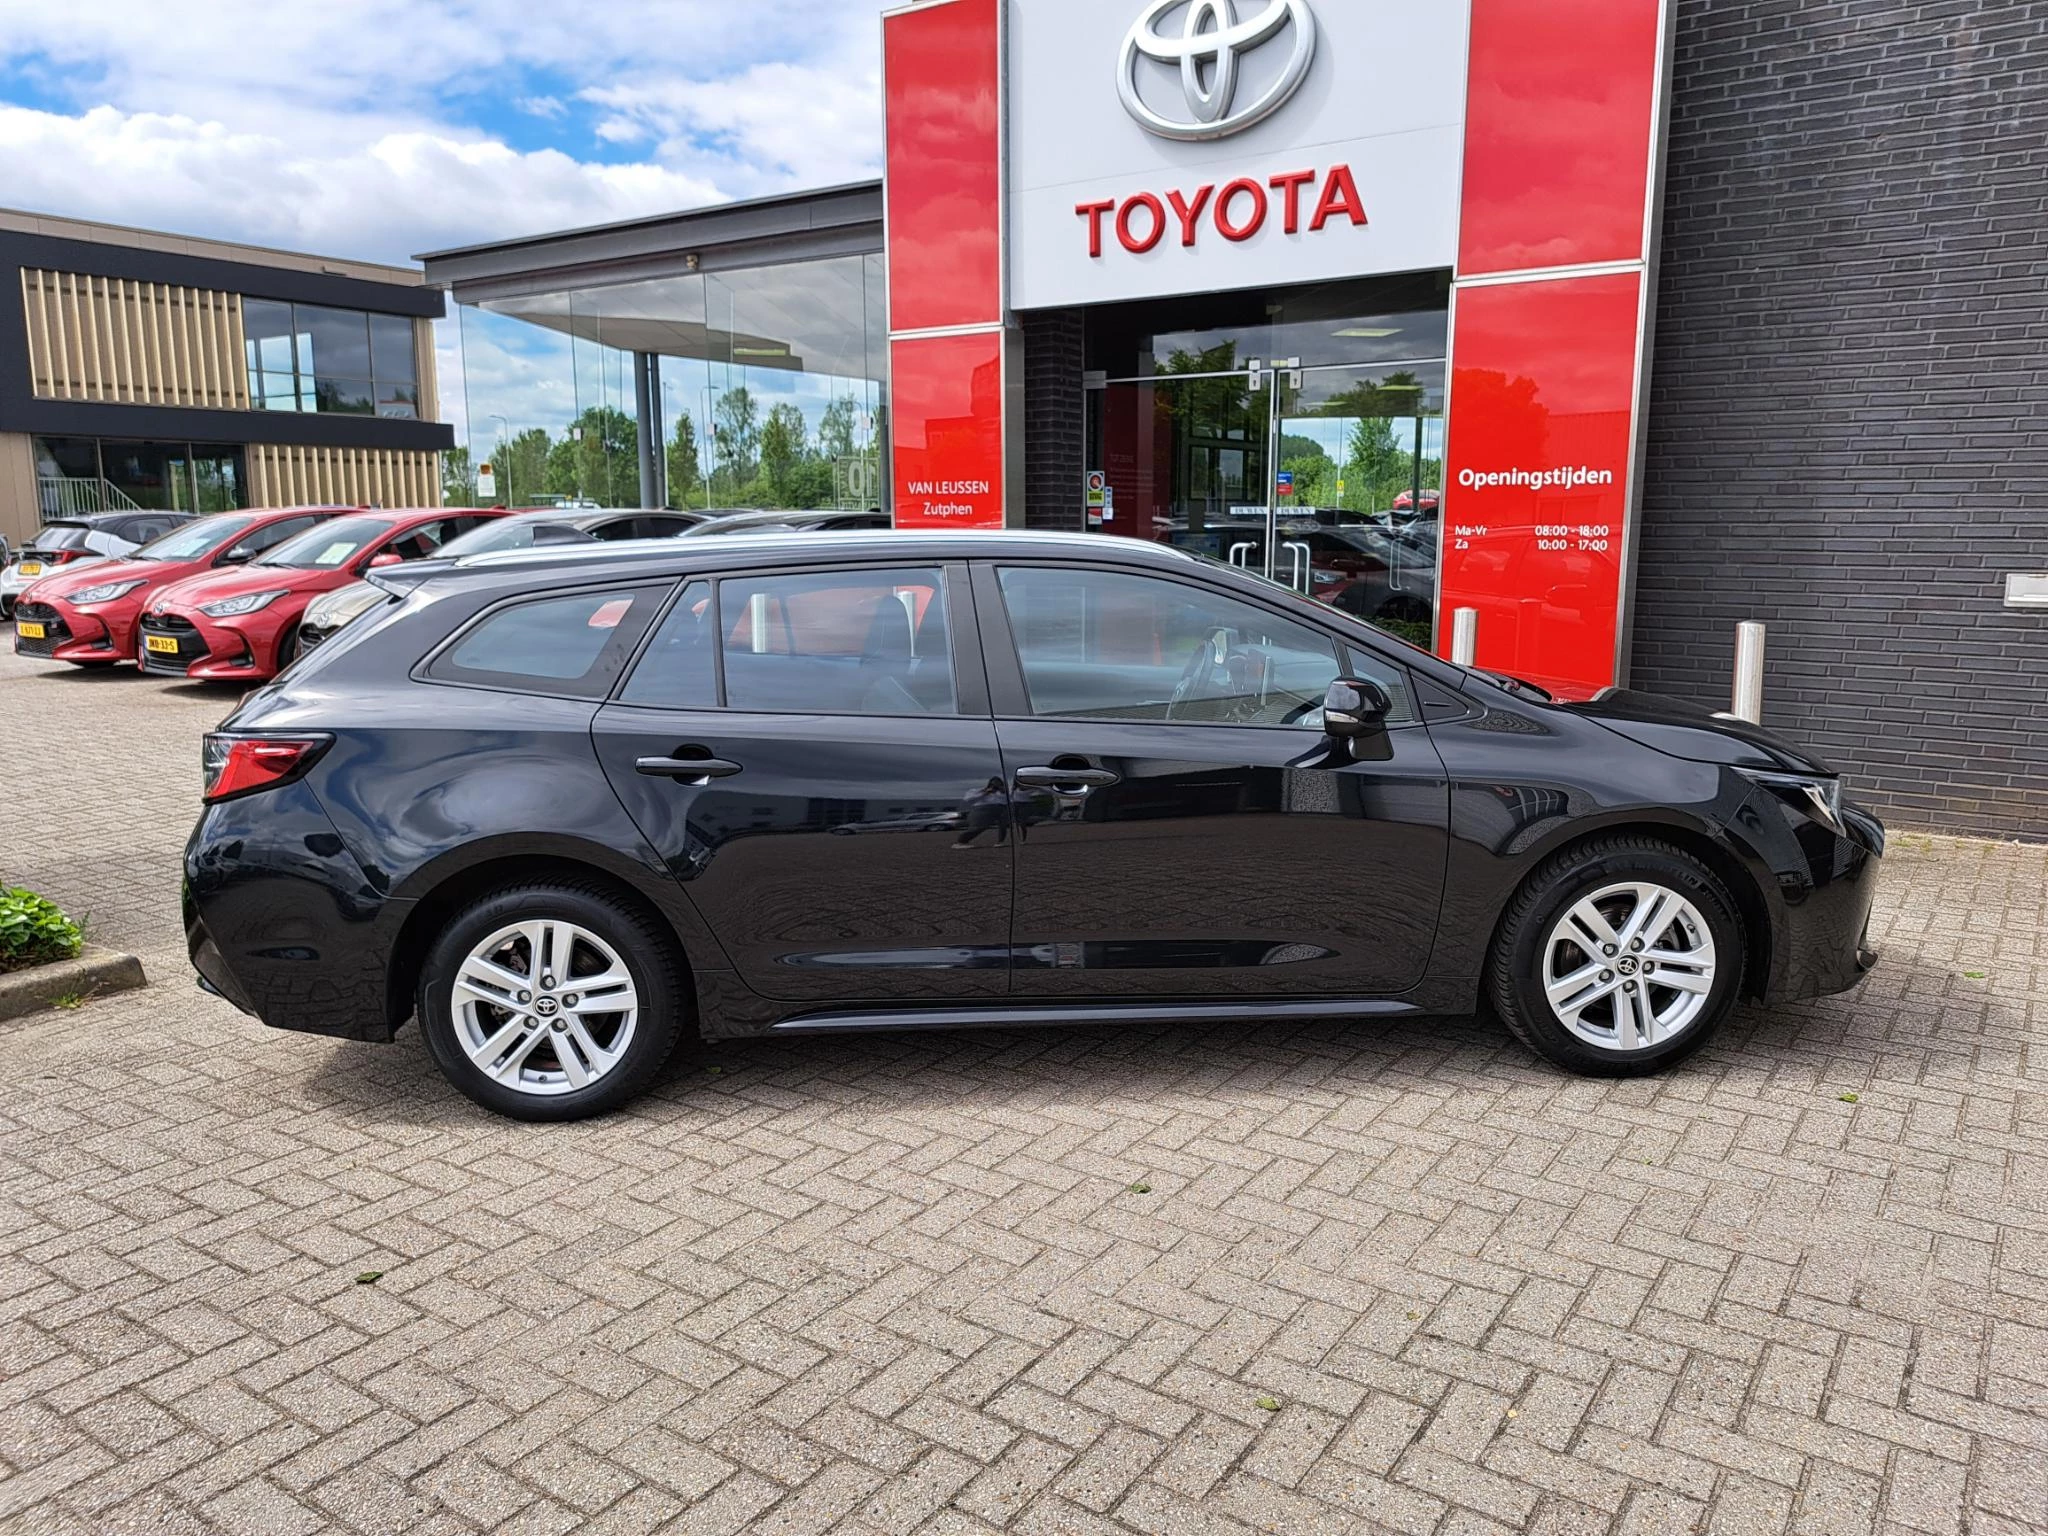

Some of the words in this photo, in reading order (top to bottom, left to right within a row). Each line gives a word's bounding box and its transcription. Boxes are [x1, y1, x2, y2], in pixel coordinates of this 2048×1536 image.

[1075, 164, 1367, 257] TOYOTA
[1458, 465, 1612, 491] Openingstijden
[908, 482, 933, 495] VAN
[935, 480, 989, 495] LEUSSEN
[923, 502, 973, 518] Zutphen
[1455, 525, 1488, 537] Ma-Vr
[1535, 525, 1568, 537] 08:00
[1579, 525, 1609, 537] 18:00
[1454, 538, 1469, 550] Za
[1538, 539, 1568, 551] 10:00
[1578, 539, 1608, 551] 17:00
